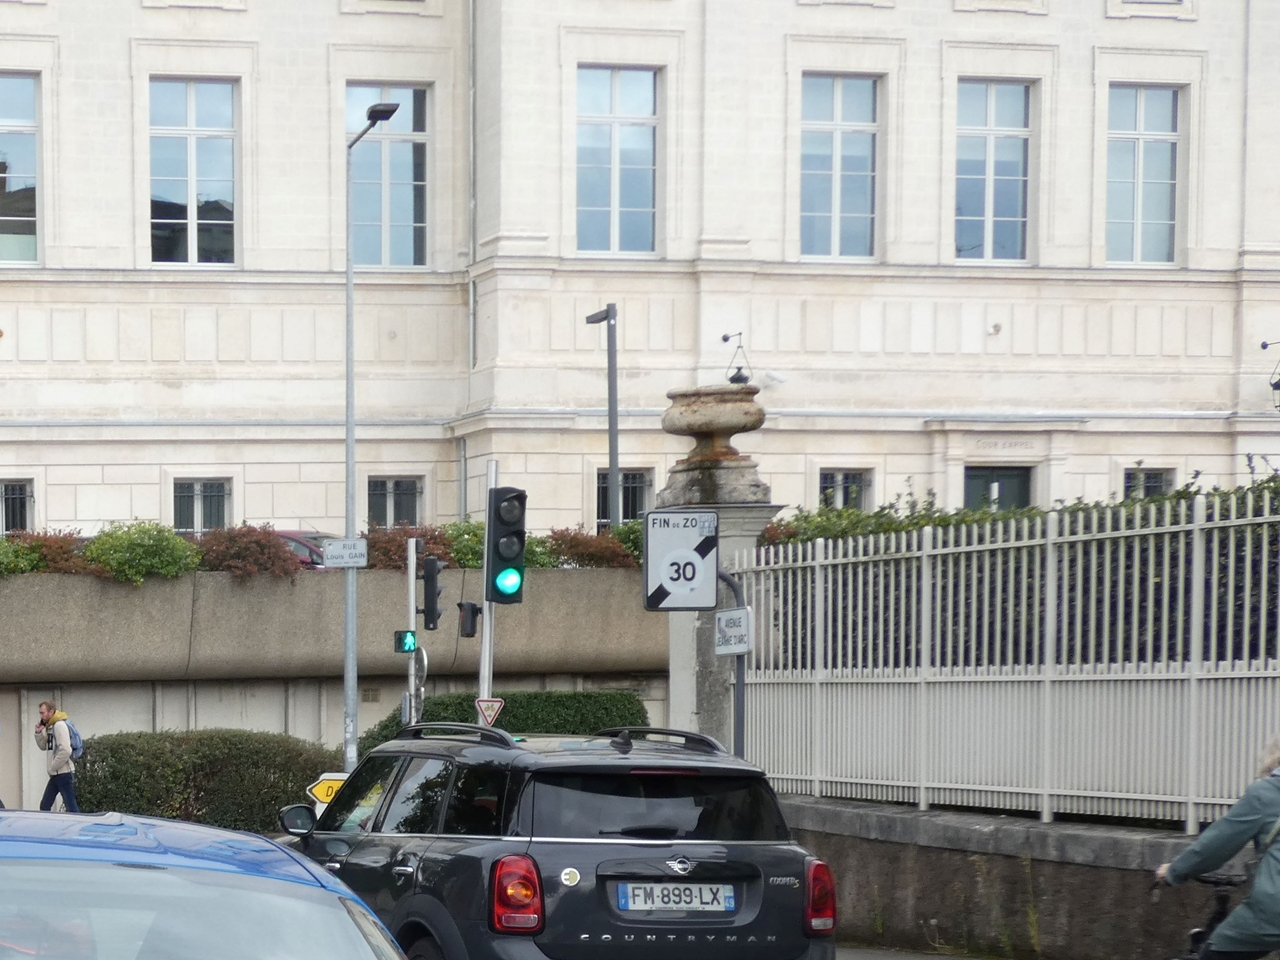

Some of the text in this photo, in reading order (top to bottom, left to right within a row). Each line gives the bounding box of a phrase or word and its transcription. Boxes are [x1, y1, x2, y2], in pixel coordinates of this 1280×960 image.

[652, 517, 670, 528] FIN
[683, 517, 698, 528] ZO
[342, 542, 357, 550] RUE
[669, 561, 696, 582] 30
[631, 886, 721, 906] FM-899-LX
[725, 898, 734, 908] 49
[580, 934, 776, 942] COUNTRYMAN
